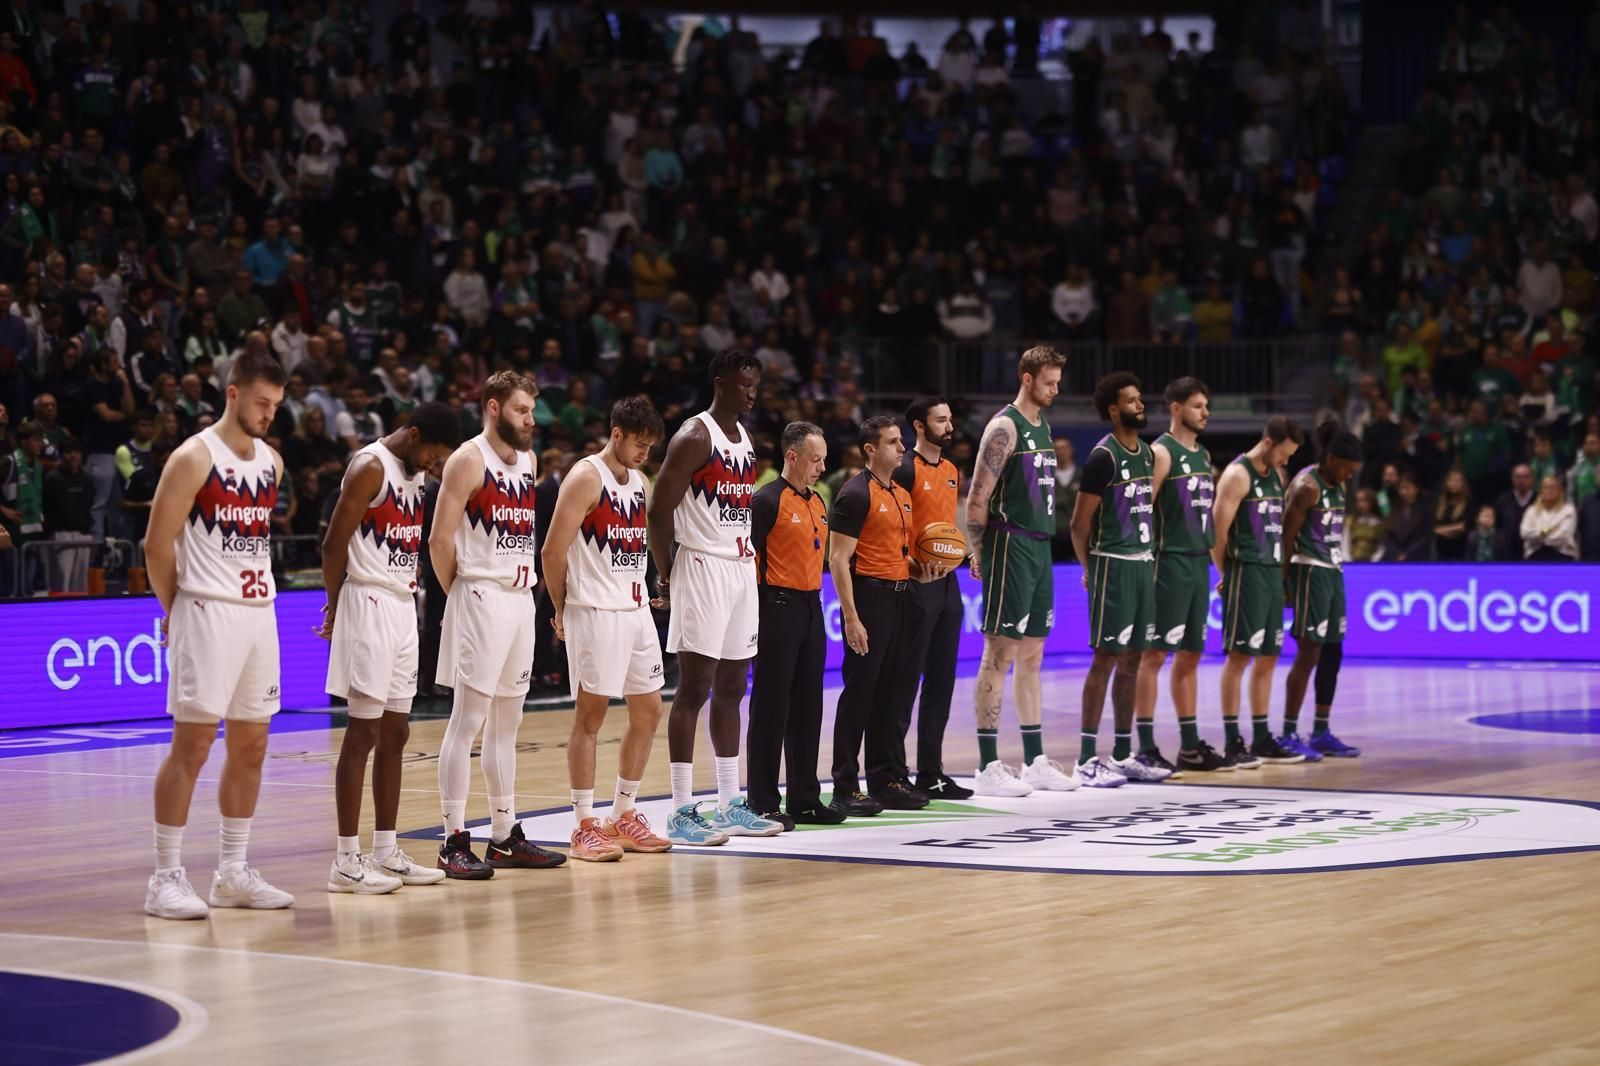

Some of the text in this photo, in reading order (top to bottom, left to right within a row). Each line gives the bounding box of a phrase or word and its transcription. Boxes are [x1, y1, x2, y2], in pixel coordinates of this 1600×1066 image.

[933, 542, 964, 556] Wilson
[1139, 522, 1150, 543] 3
[240, 570, 268, 598] 25
[631, 582, 642, 608] 4
[1363, 578, 1590, 634] endesa
[47, 617, 170, 690] end
[1081, 808, 1381, 847] Unicaja
[1148, 807, 1521, 863] Baloncesto
